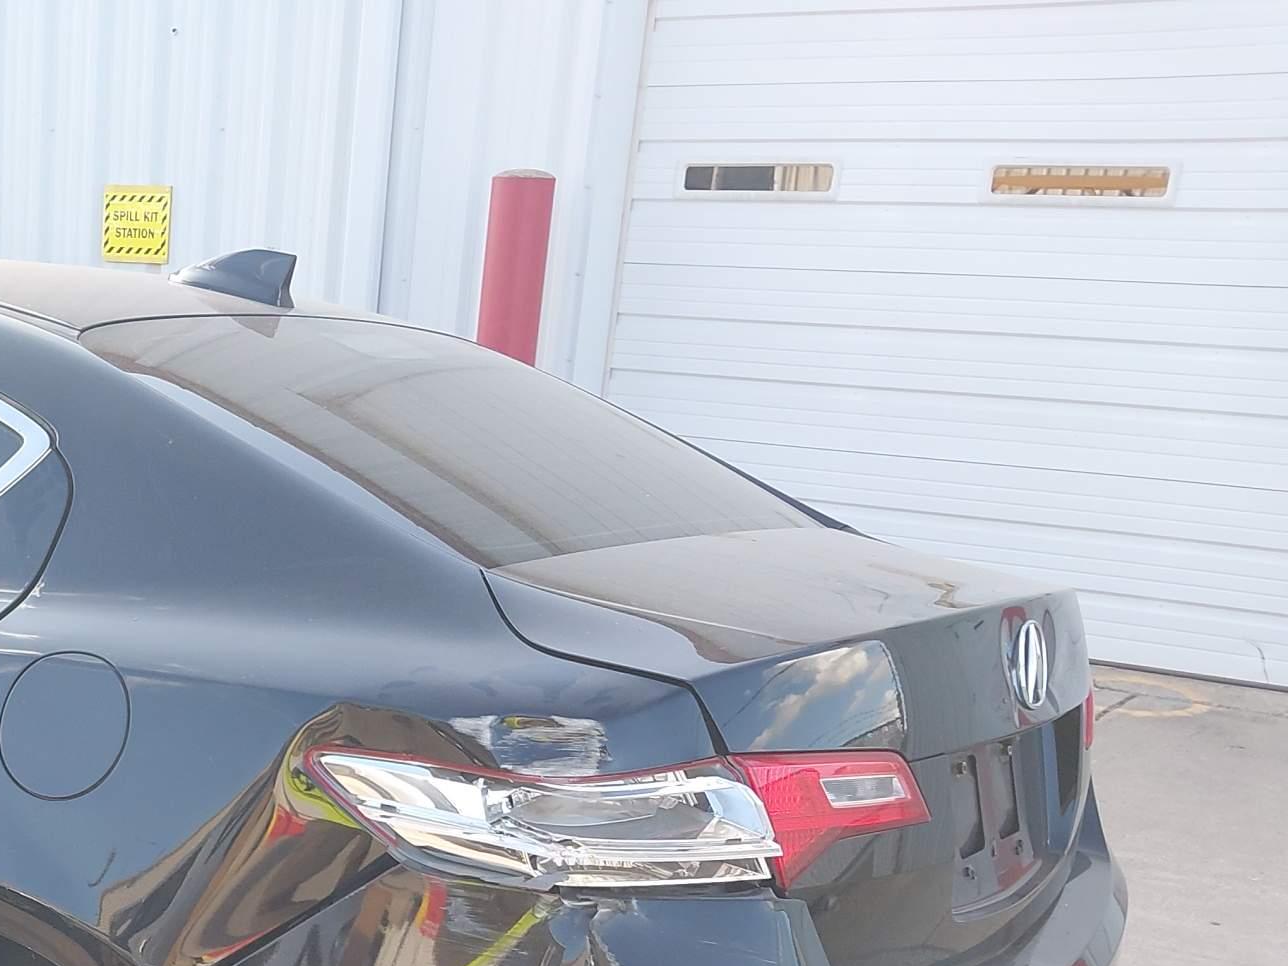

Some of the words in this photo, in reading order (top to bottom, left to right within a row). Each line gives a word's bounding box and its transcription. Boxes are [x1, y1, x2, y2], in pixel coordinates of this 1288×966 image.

[113, 211, 140, 222] SPILL
[143, 212, 159, 222] KIT
[115, 228, 154, 239] STATION
